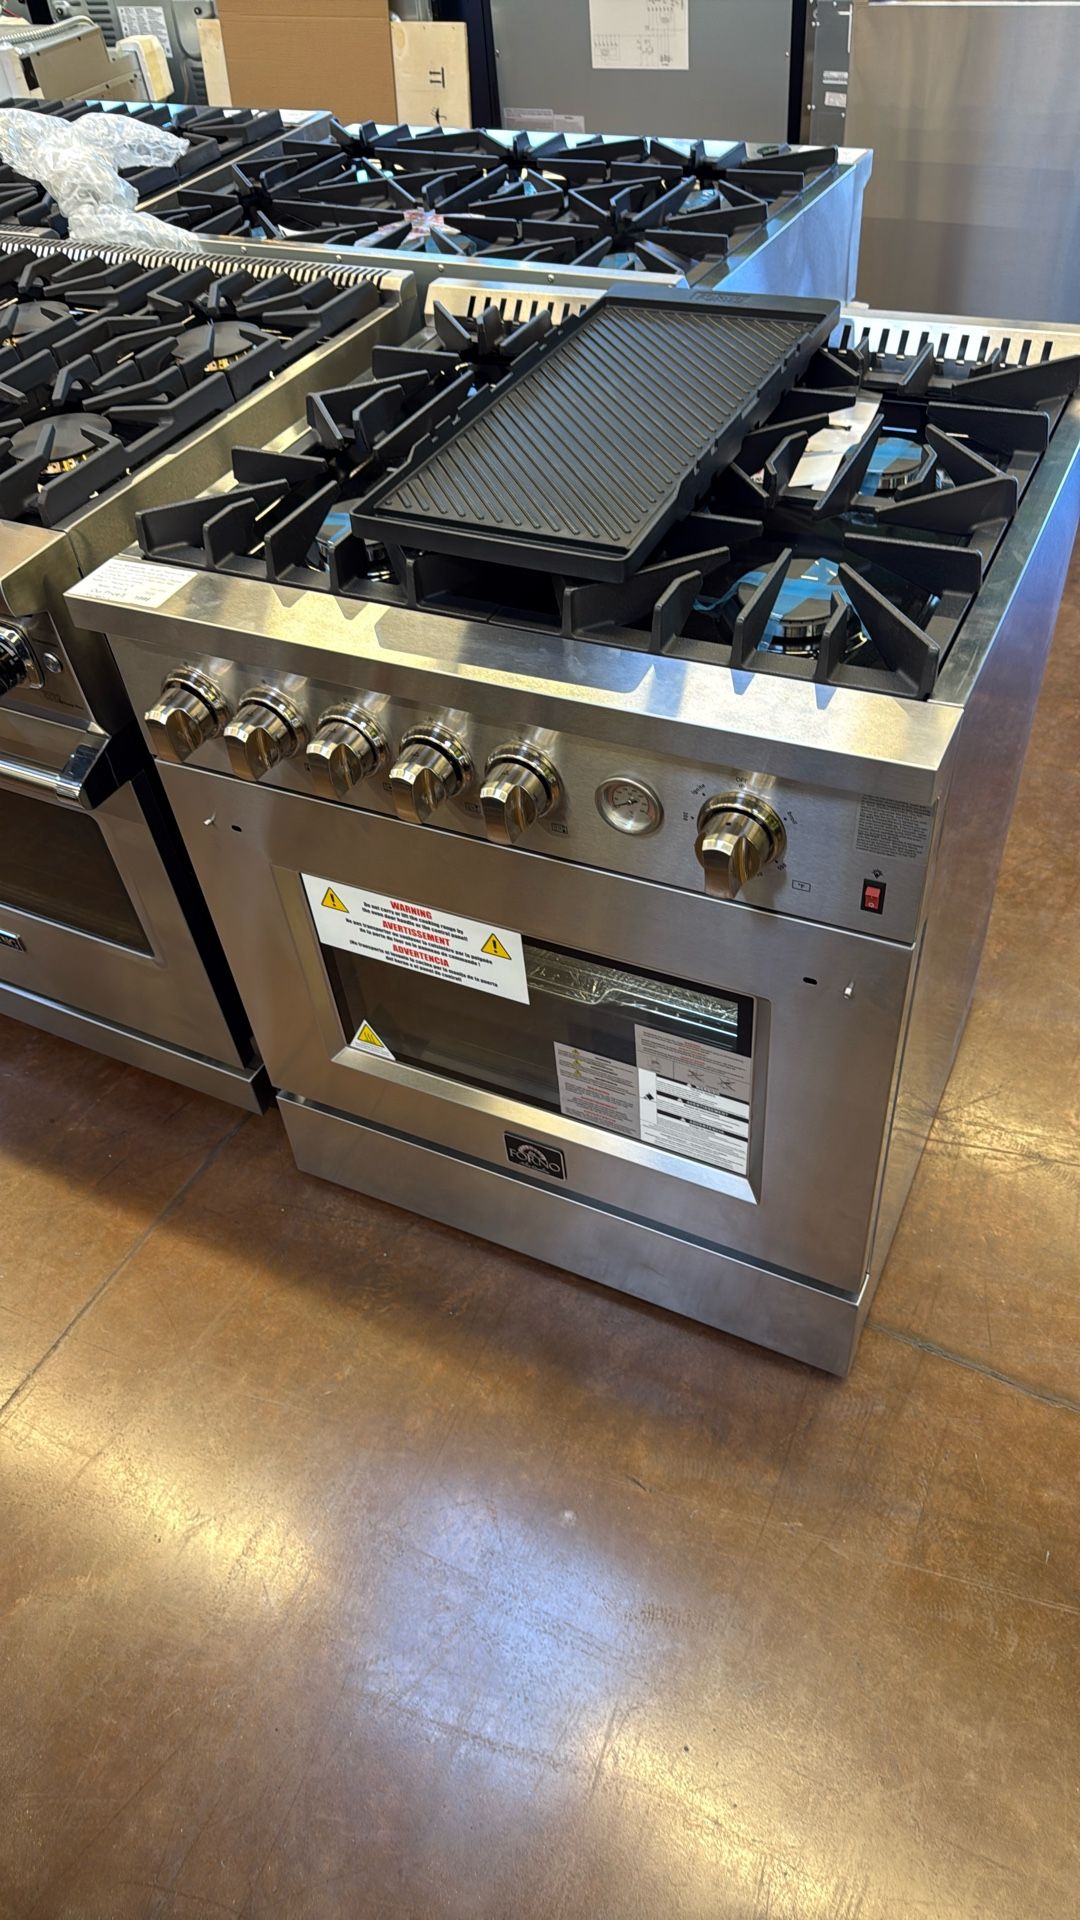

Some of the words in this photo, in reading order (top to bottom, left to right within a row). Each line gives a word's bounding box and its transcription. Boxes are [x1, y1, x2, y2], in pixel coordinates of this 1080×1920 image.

[390, 901, 433, 920] WARNING
[382, 920, 451, 946] AVERTISSEMENT
[418, 918, 440, 928] cooking
[392, 944, 449, 967] ADVERTENCIA
[509, 1147, 561, 1172] FORNO
